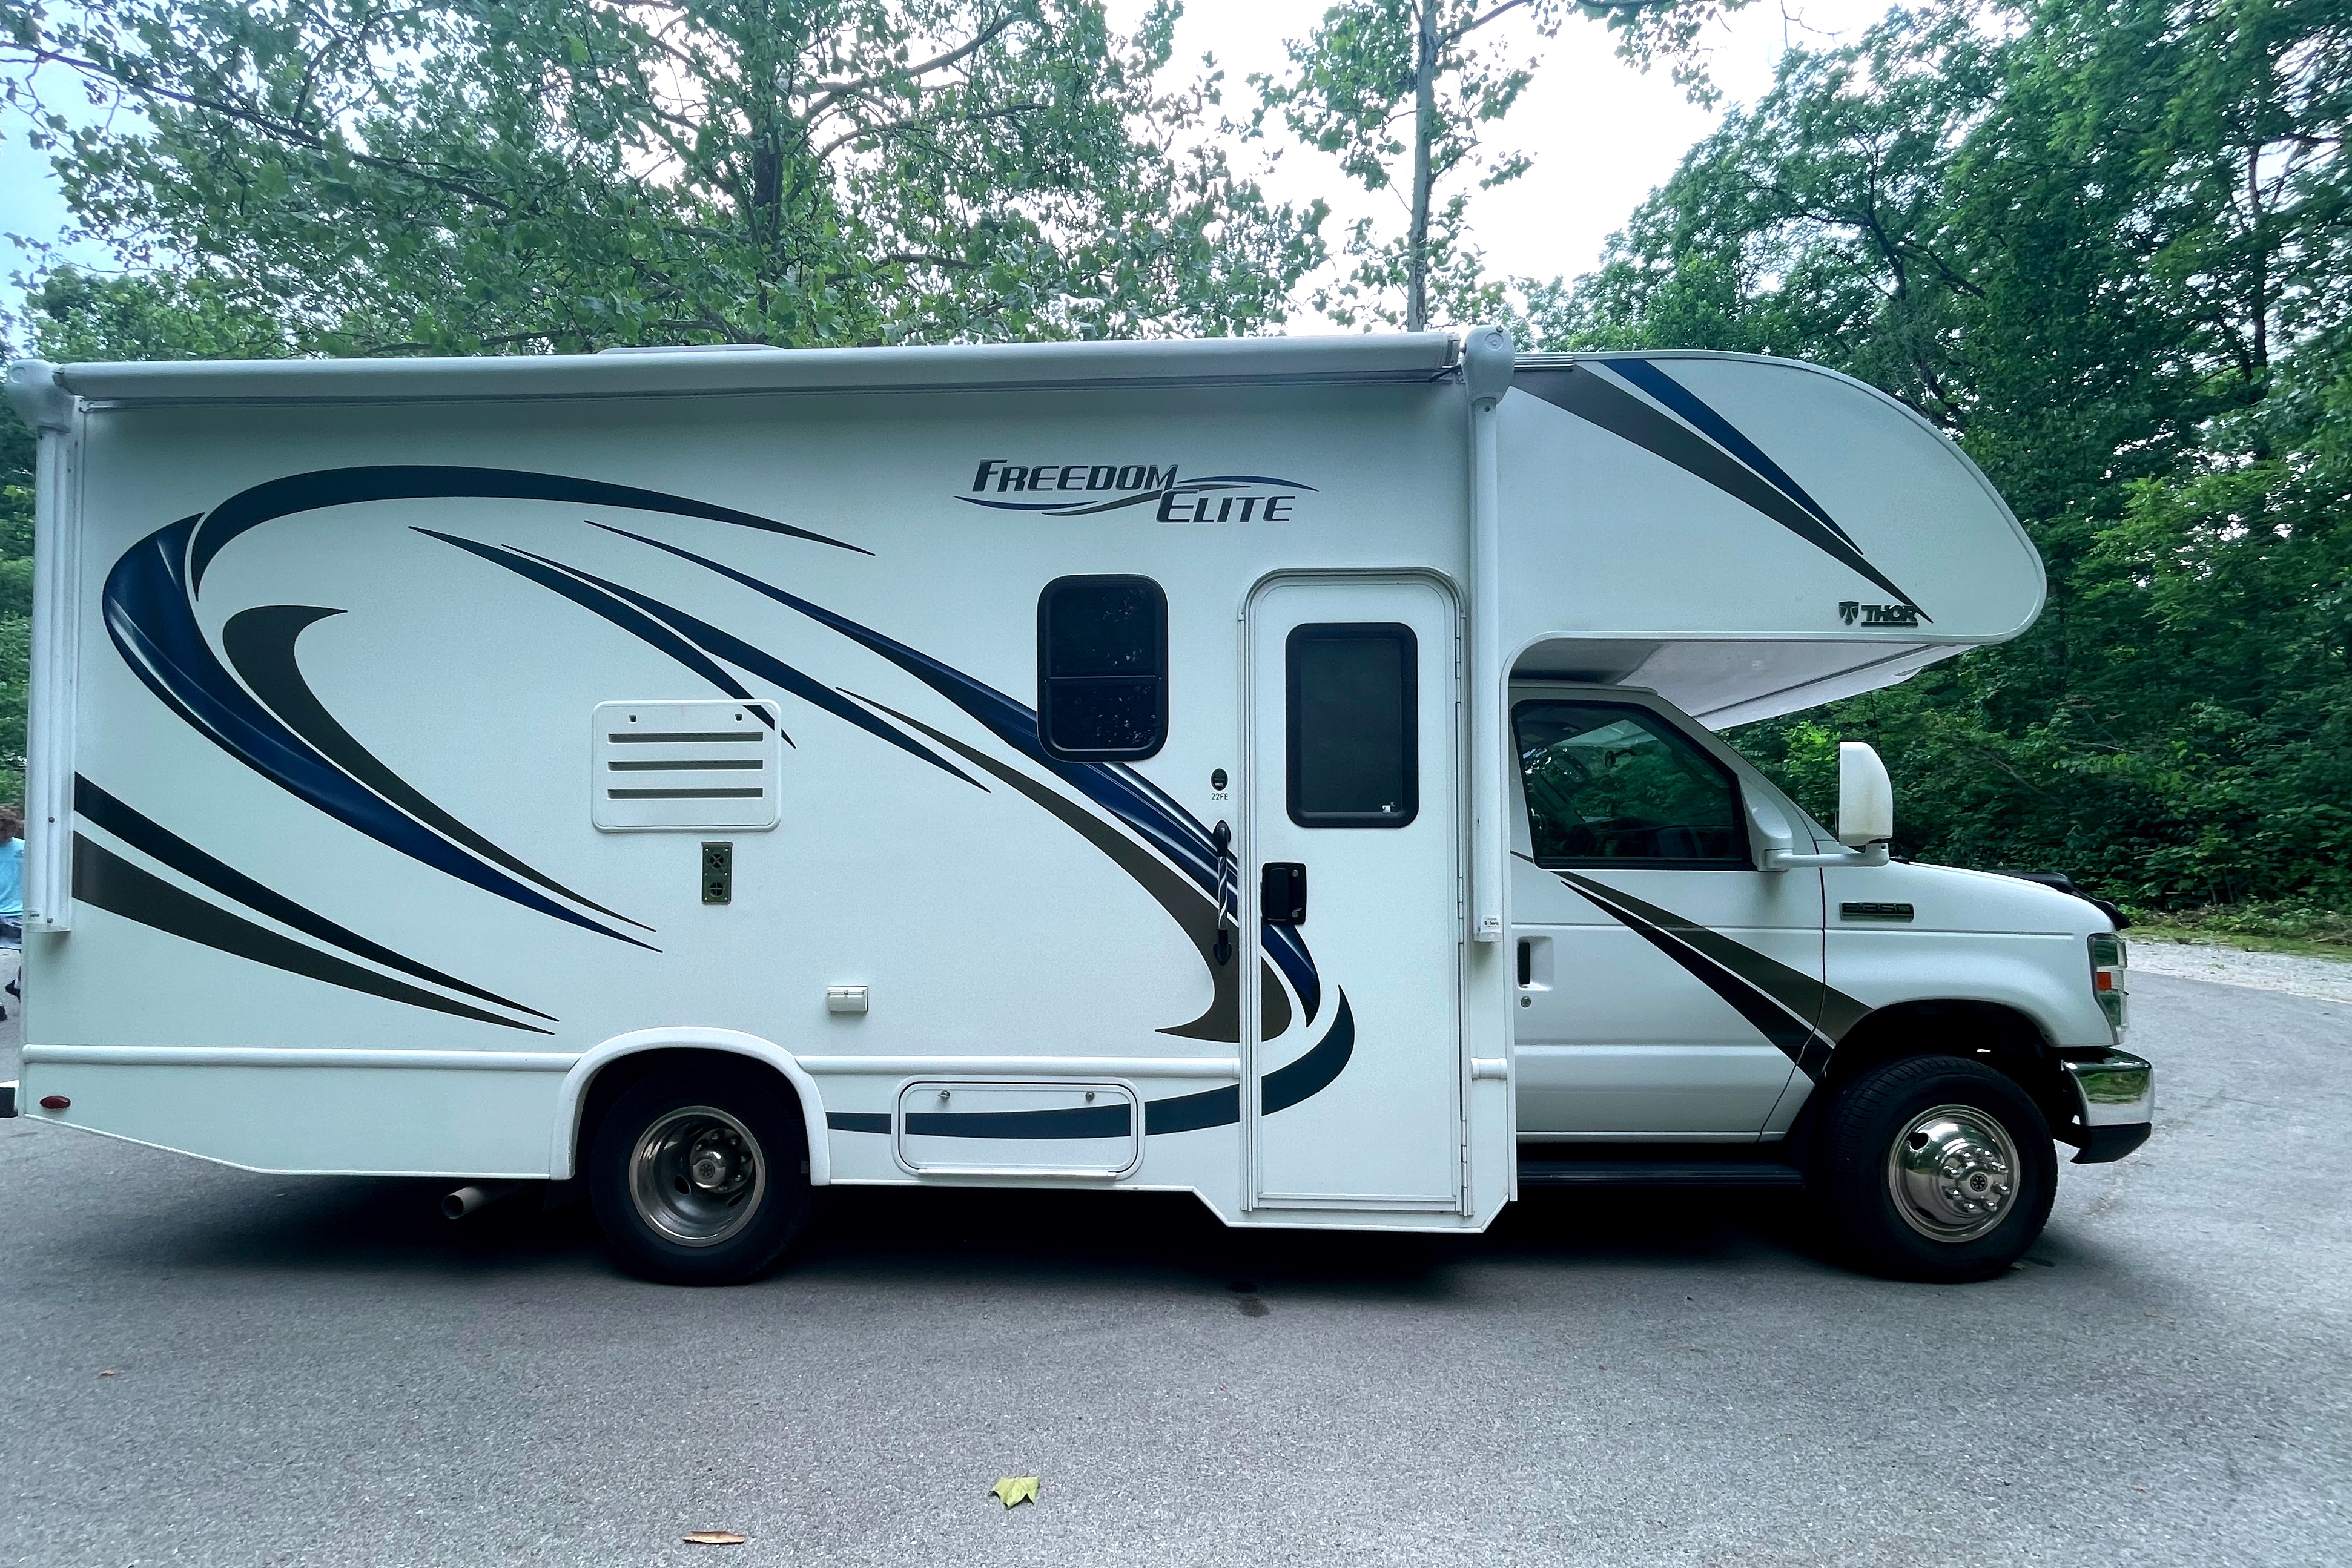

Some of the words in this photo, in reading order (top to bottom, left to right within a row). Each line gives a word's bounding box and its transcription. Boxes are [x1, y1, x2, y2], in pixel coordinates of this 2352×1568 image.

[971, 458, 1179, 492] FREEDOM
[1155, 489, 1297, 523] ELITE
[1861, 604, 1918, 622] THOR
